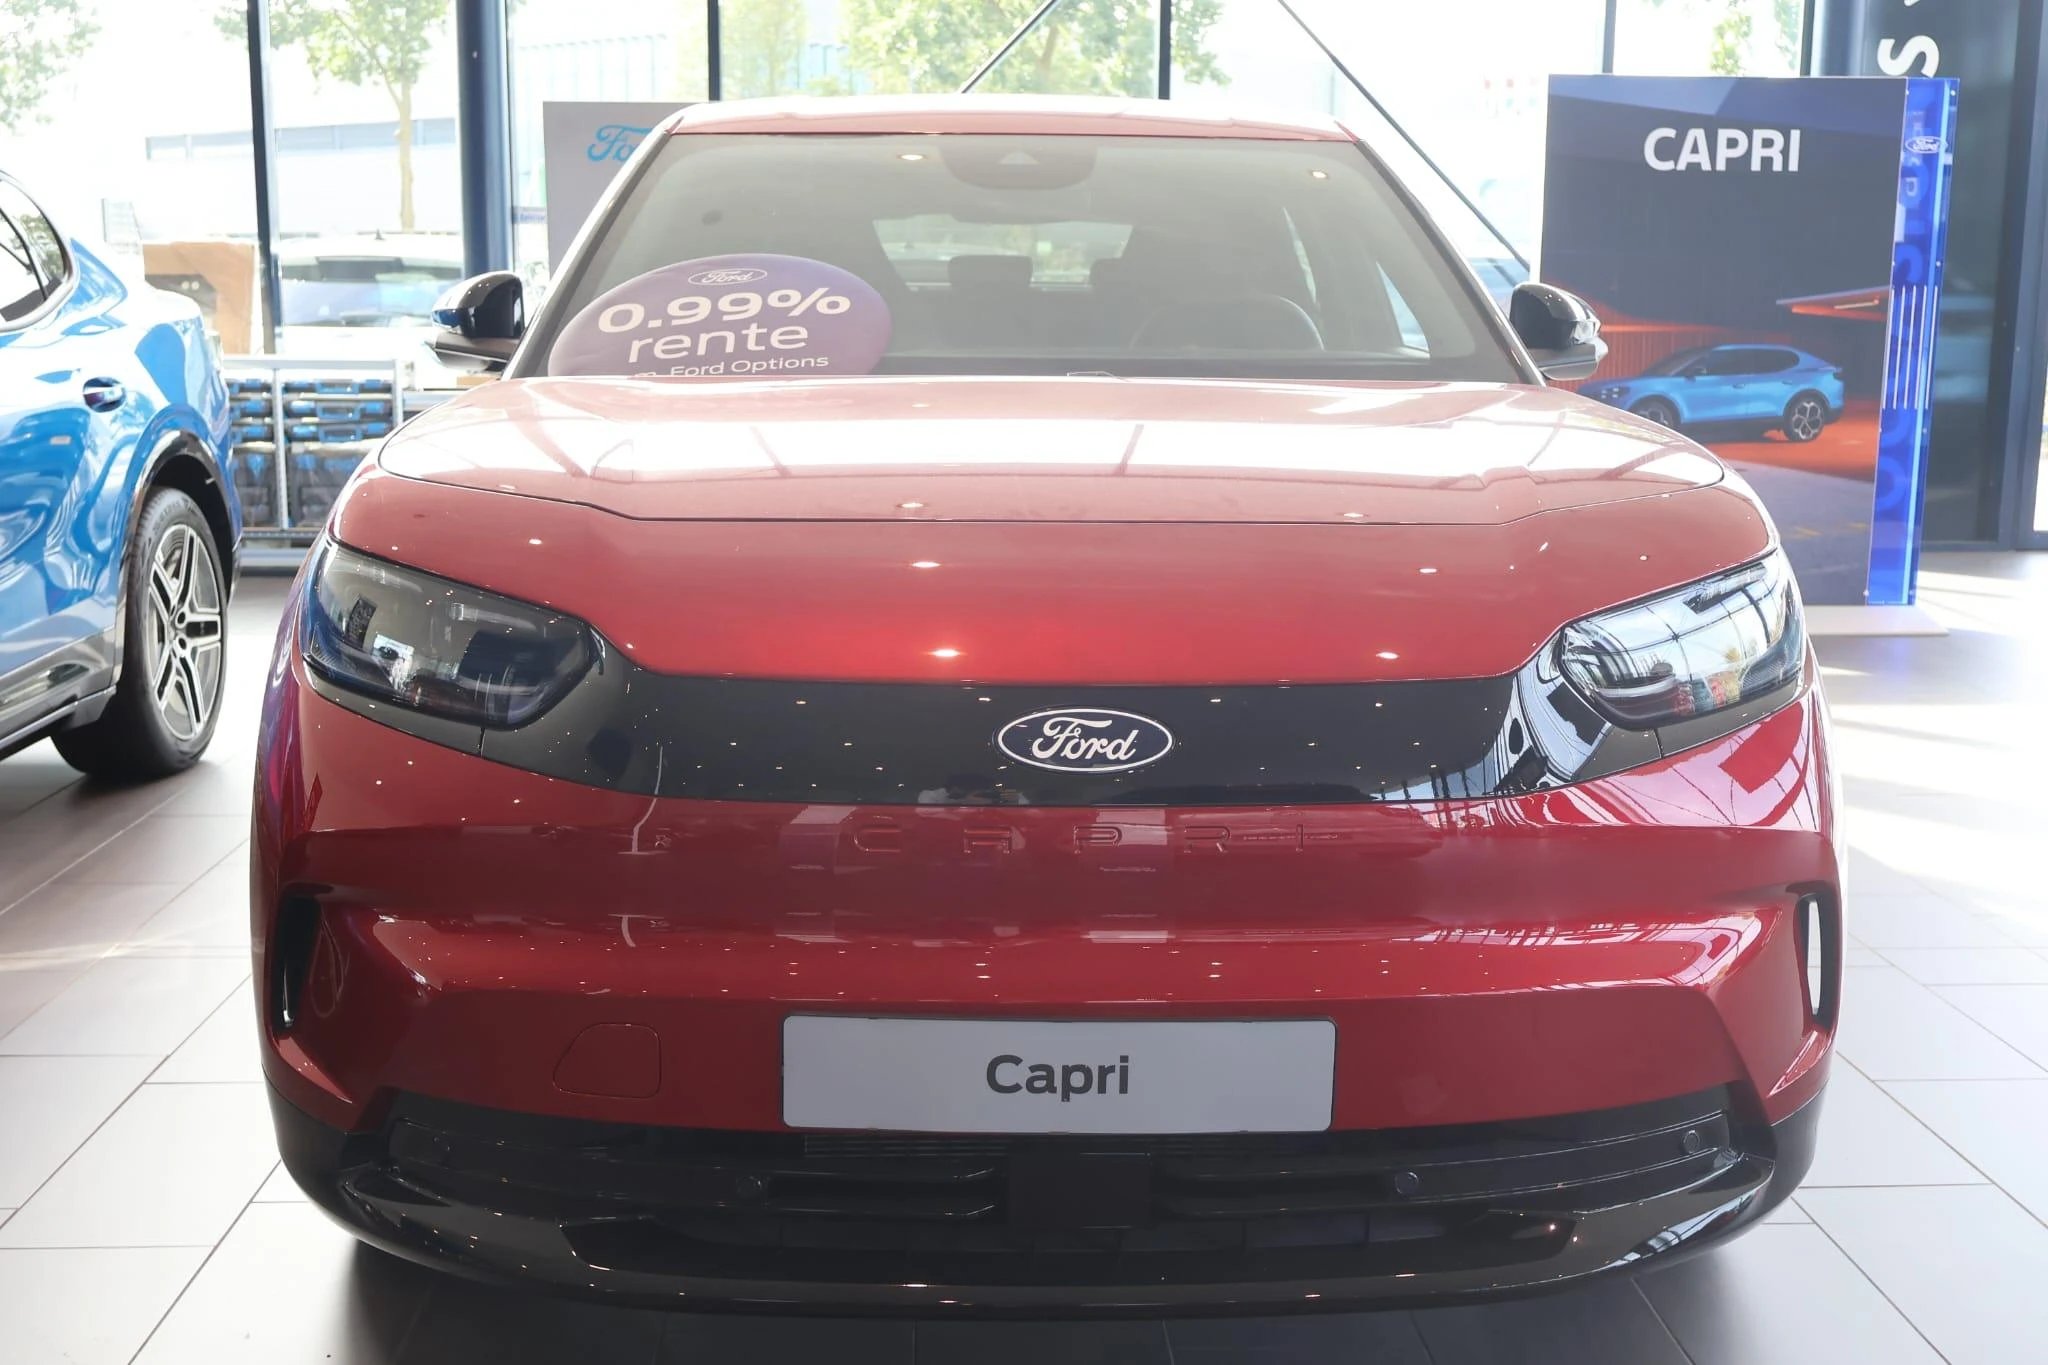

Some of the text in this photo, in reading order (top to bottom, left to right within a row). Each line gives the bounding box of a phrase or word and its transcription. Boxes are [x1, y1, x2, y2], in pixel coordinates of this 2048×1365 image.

[587, 124, 653, 162] Fo
[1643, 128, 1800, 172] CAPRI
[702, 270, 754, 283] Ford
[598, 287, 851, 333] 0.99%
[628, 322, 808, 363] rente
[669, 355, 830, 376] Ford Options
[1031, 715, 1137, 762] Ford
[853, 824, 1304, 854] CAPRI
[985, 1054, 1130, 1103] Capri
